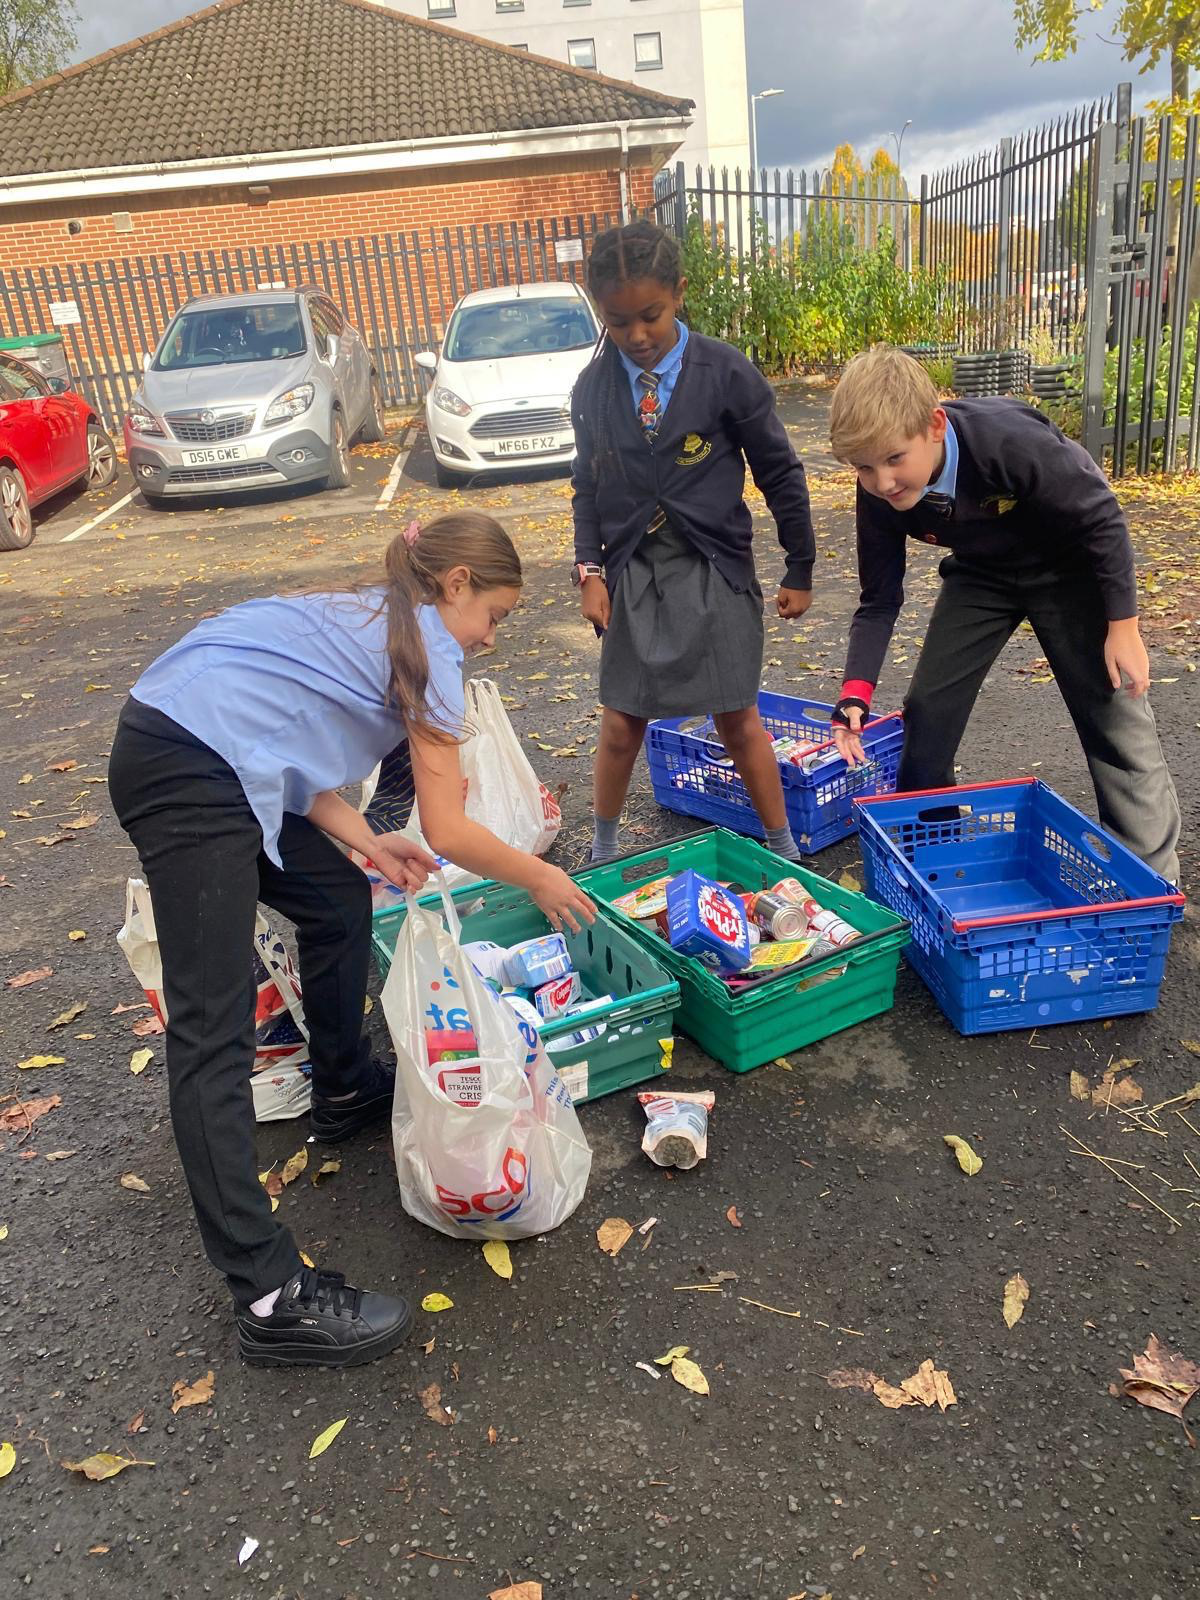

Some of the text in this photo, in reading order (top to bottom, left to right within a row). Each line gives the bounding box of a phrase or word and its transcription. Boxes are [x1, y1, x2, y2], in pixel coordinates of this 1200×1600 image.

[498, 436, 555, 453] MF66 FXZ
[189, 447, 240, 464] DS15 GWE
